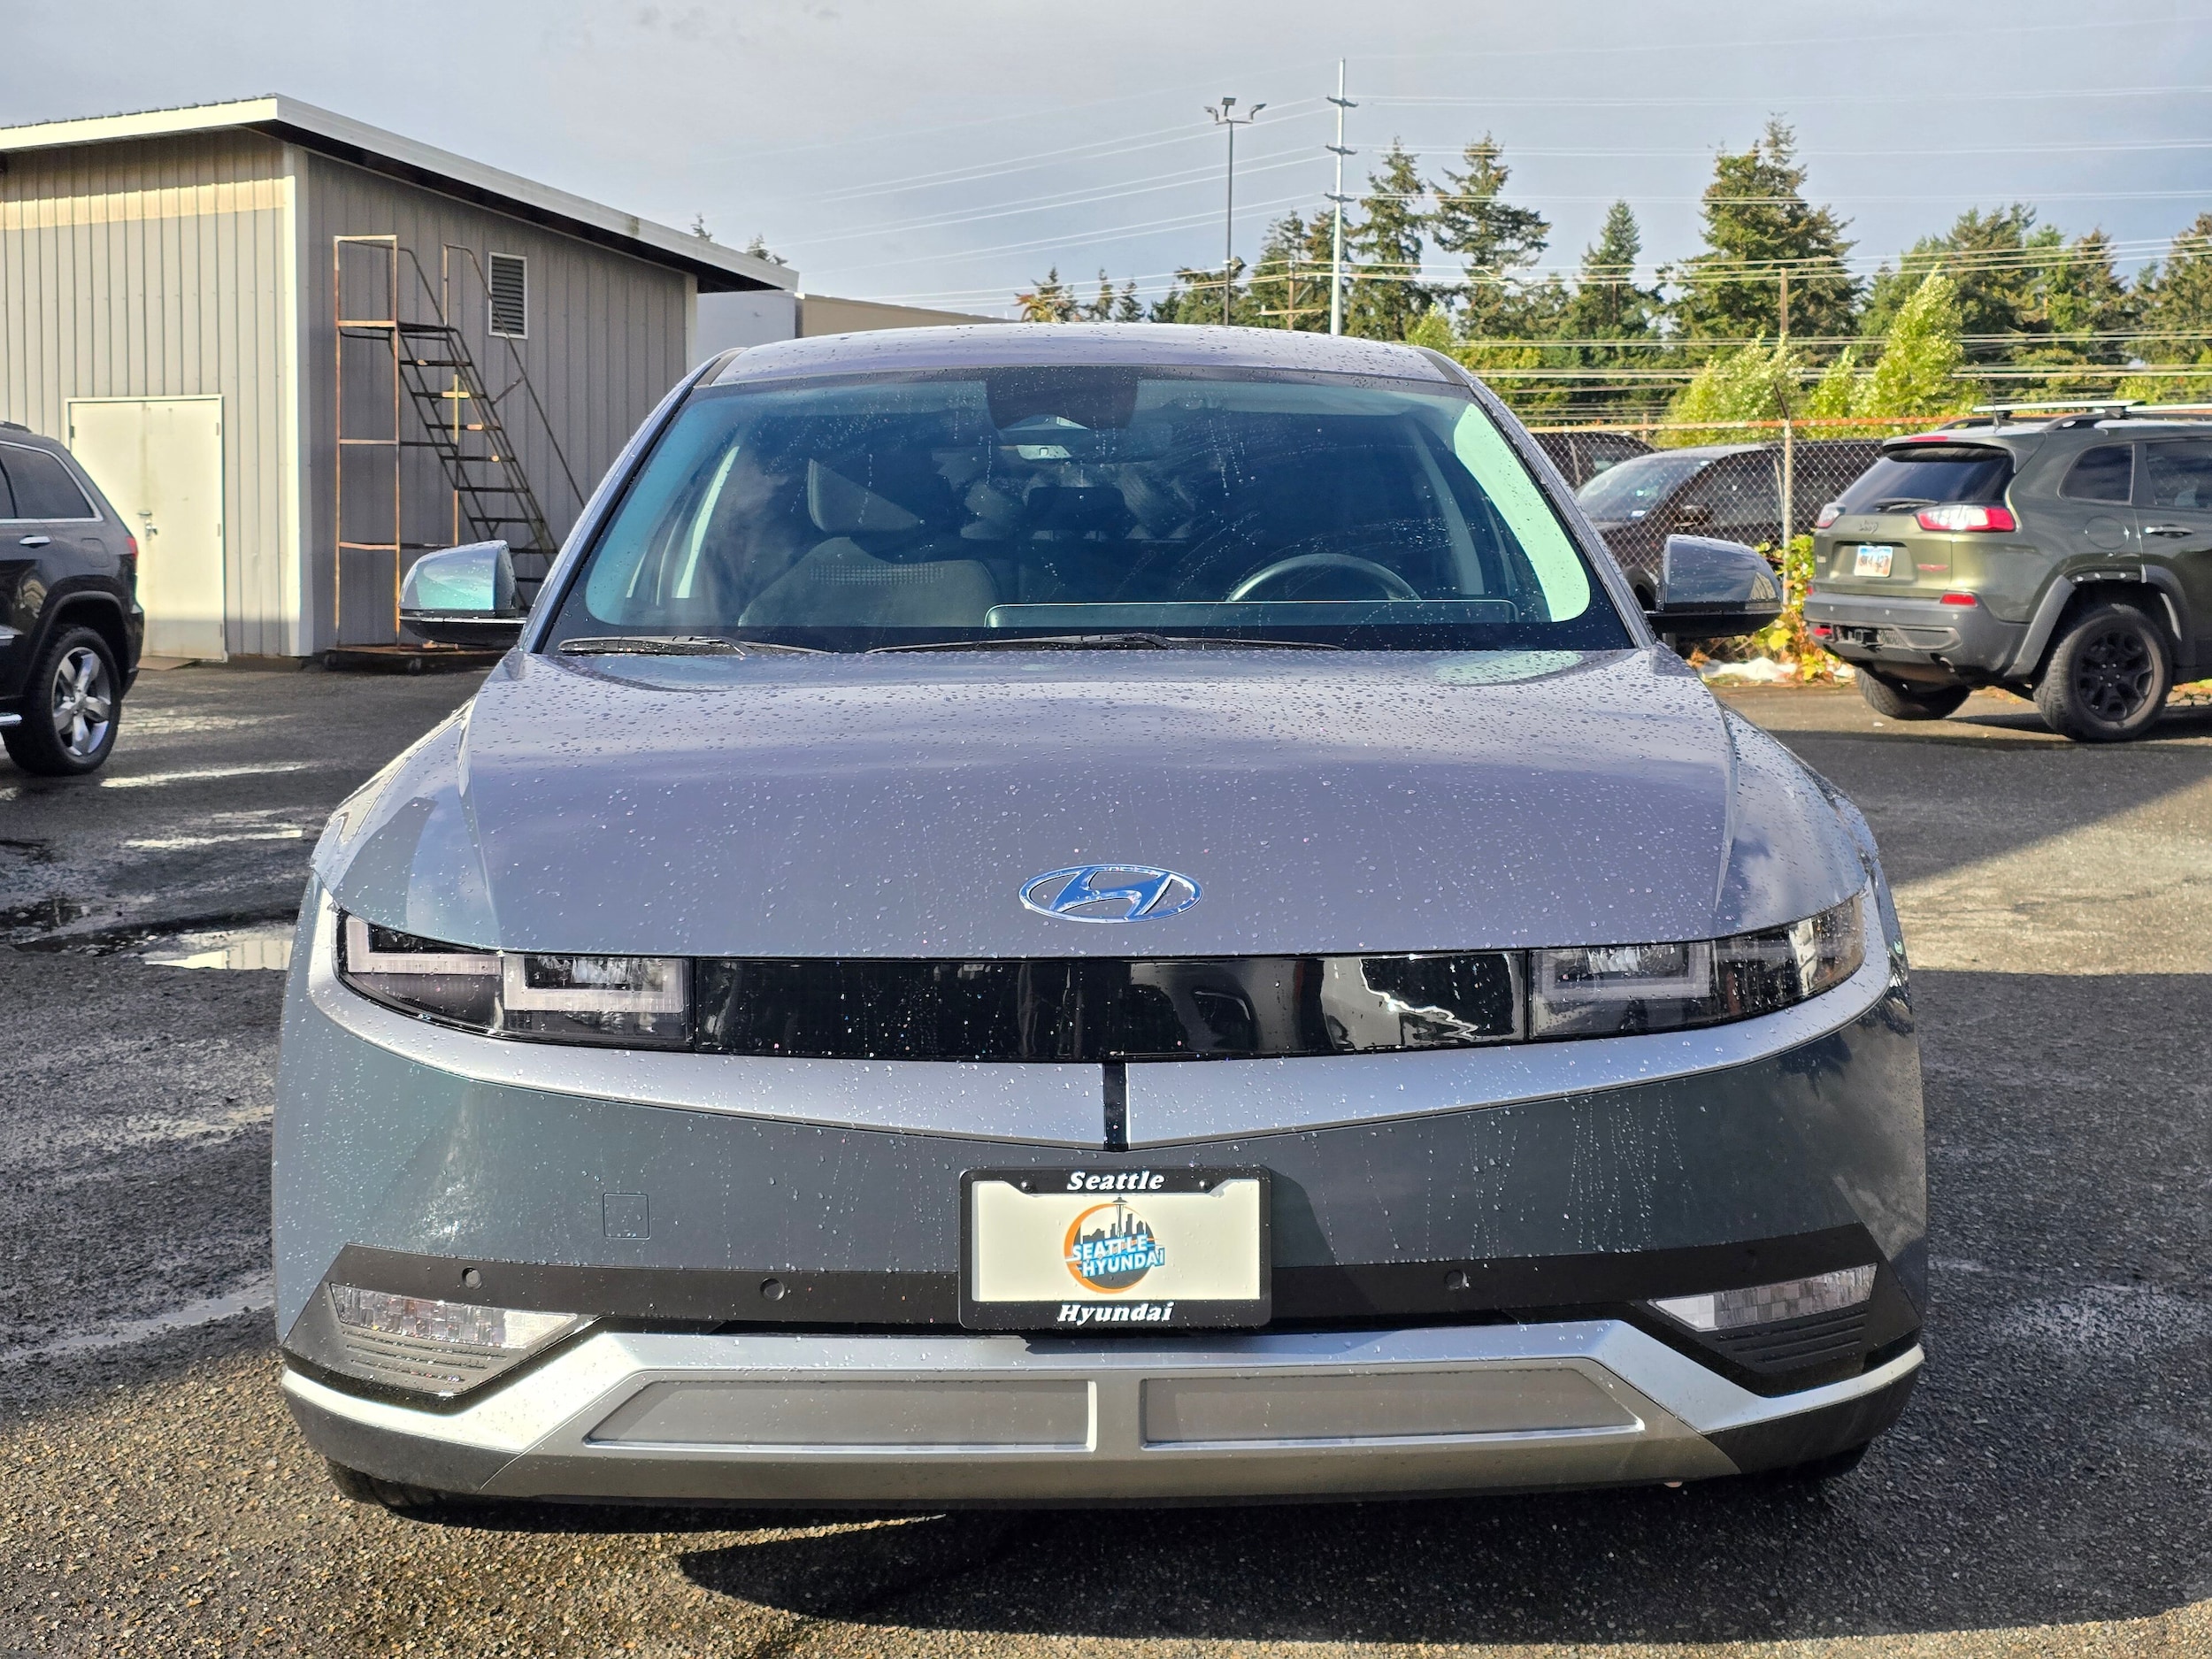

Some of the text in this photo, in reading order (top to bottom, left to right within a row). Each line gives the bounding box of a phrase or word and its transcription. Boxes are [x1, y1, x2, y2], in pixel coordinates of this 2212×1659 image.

[1066, 1171, 1165, 1191] Seattle
[1072, 1234, 1148, 1261] SEATTLE
[1082, 1248, 1165, 1277] HYUNDAI
[1056, 1302, 1174, 1325] Hyundai
